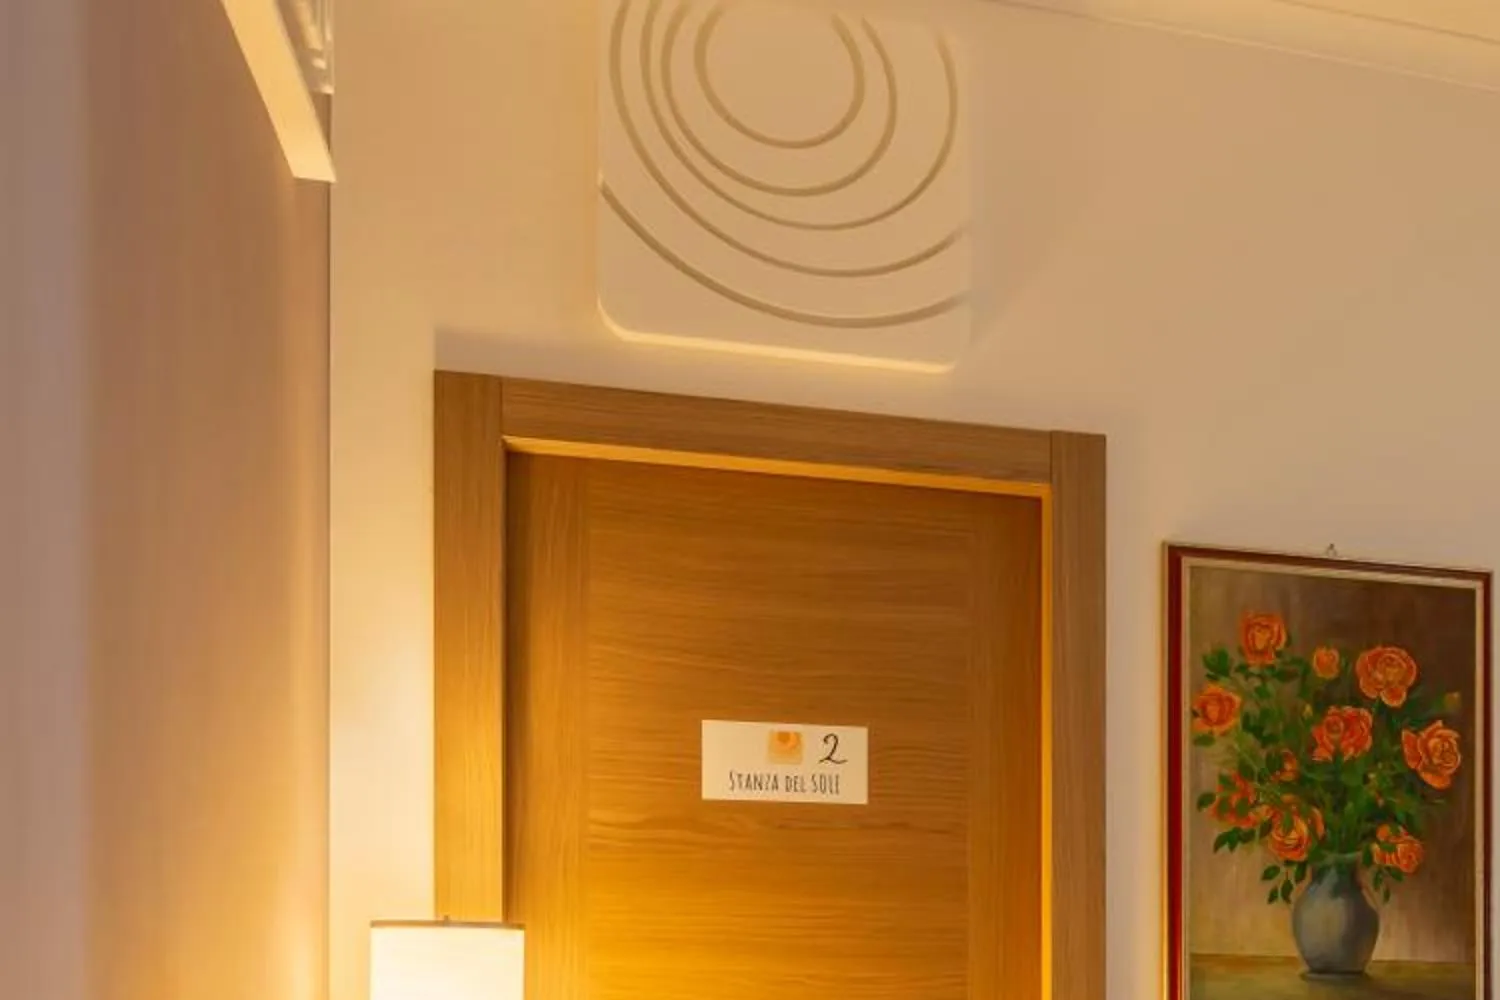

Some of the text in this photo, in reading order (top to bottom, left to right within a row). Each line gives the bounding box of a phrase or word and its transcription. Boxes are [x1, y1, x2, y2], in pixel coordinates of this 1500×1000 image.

[818, 733, 848, 764] 2
[729, 770, 840, 795] STANZA DEL SOLE
